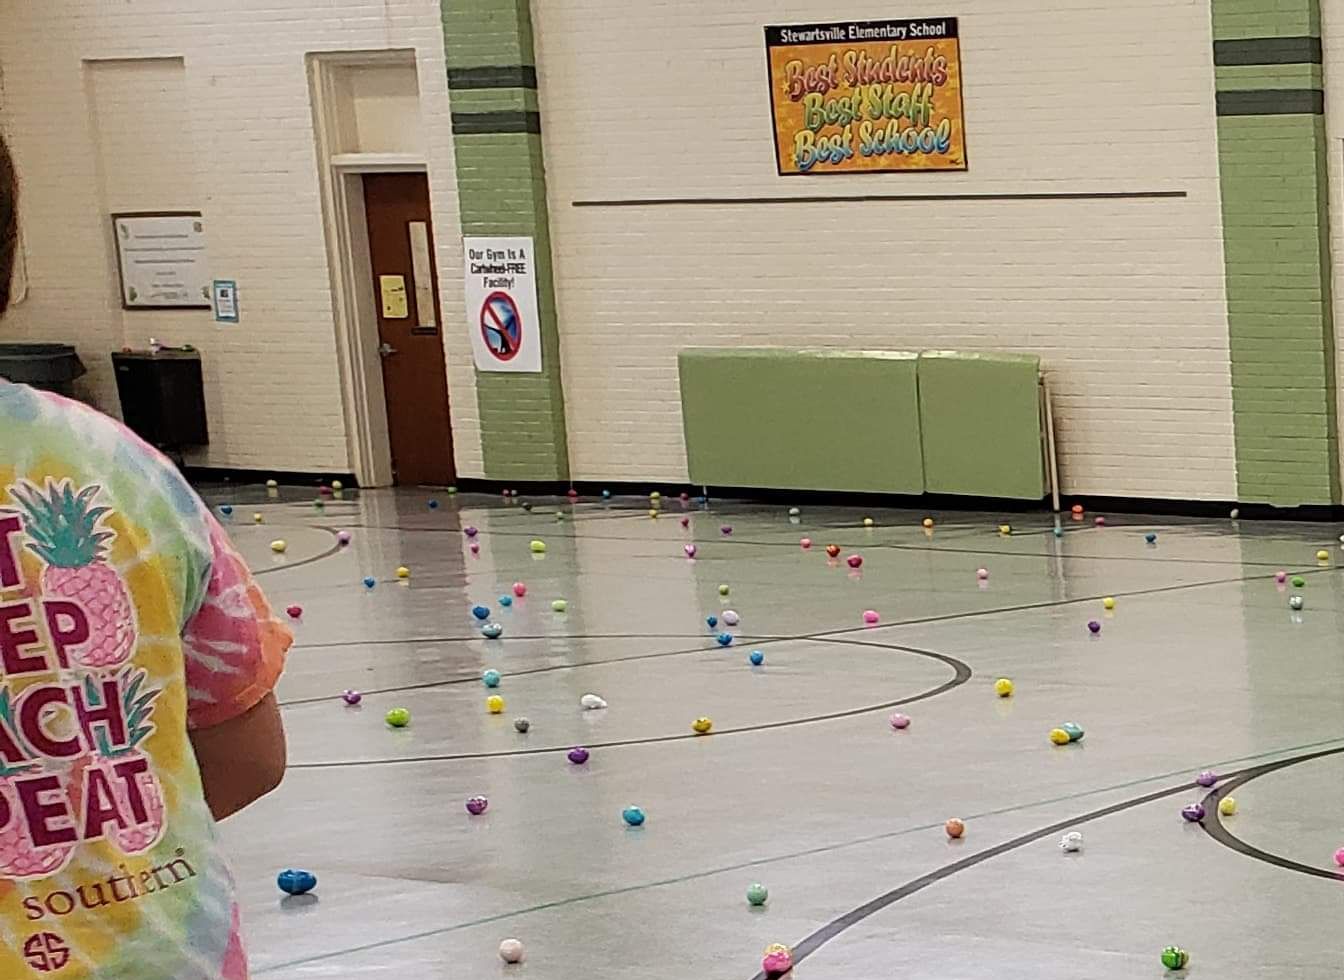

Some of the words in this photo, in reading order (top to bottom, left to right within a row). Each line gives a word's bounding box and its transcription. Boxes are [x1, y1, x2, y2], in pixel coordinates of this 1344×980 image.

[780, 29, 846, 43] Stewartsville
[848, 24, 907, 40] Elementary
[909, 22, 946, 37] School
[785, 54, 838, 100] Best
[843, 45, 948, 87] Students
[803, 87, 863, 131] Best
[867, 82, 935, 127] Staff
[794, 124, 853, 171] Best
[858, 118, 950, 158] School
[469, 249, 483, 260] Our
[486, 249, 505, 262] Gym
[519, 248, 525, 260] A
